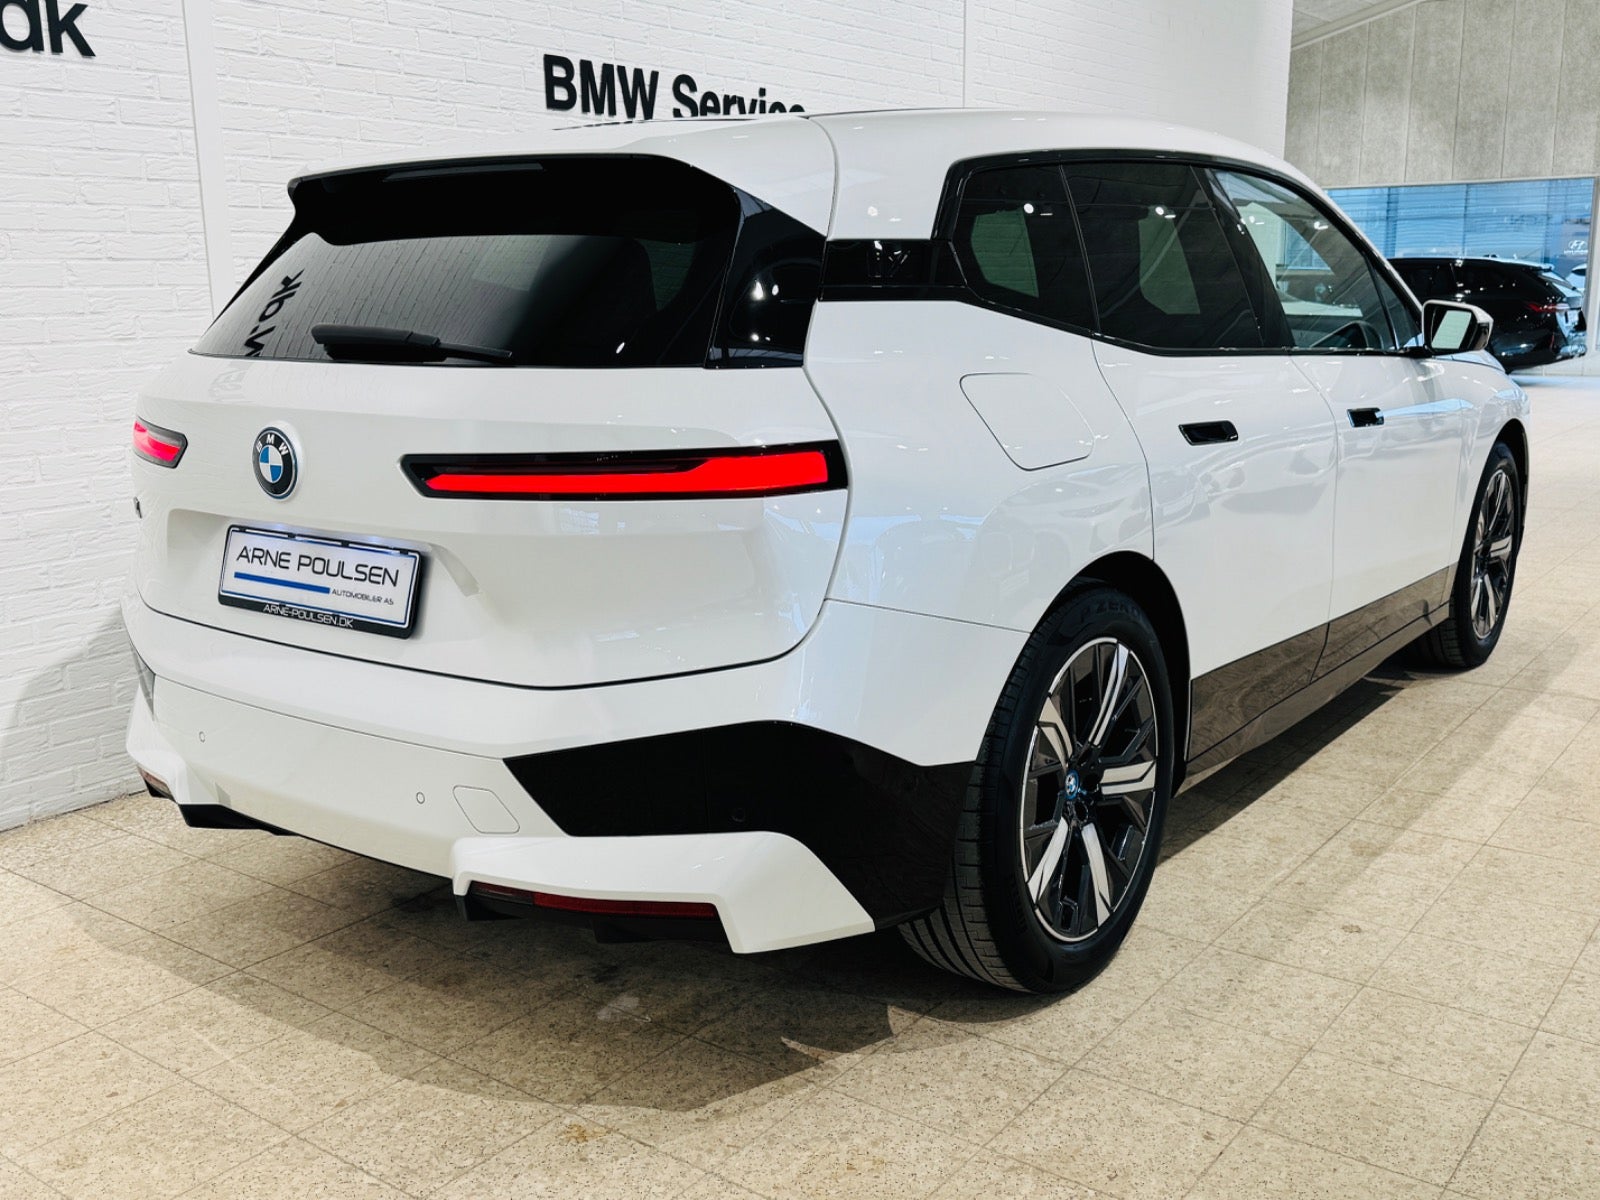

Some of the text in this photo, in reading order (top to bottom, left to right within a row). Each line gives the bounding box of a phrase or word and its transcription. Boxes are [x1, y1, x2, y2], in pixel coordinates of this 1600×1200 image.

[543, 54, 805, 120] BMW Servi
[255, 433, 289, 456] BMW
[236, 545, 399, 588] ARNE POULSEN
[332, 588, 383, 603] AUTOMOBILER
[263, 603, 354, 628] ARNE-POULSEN.DK
